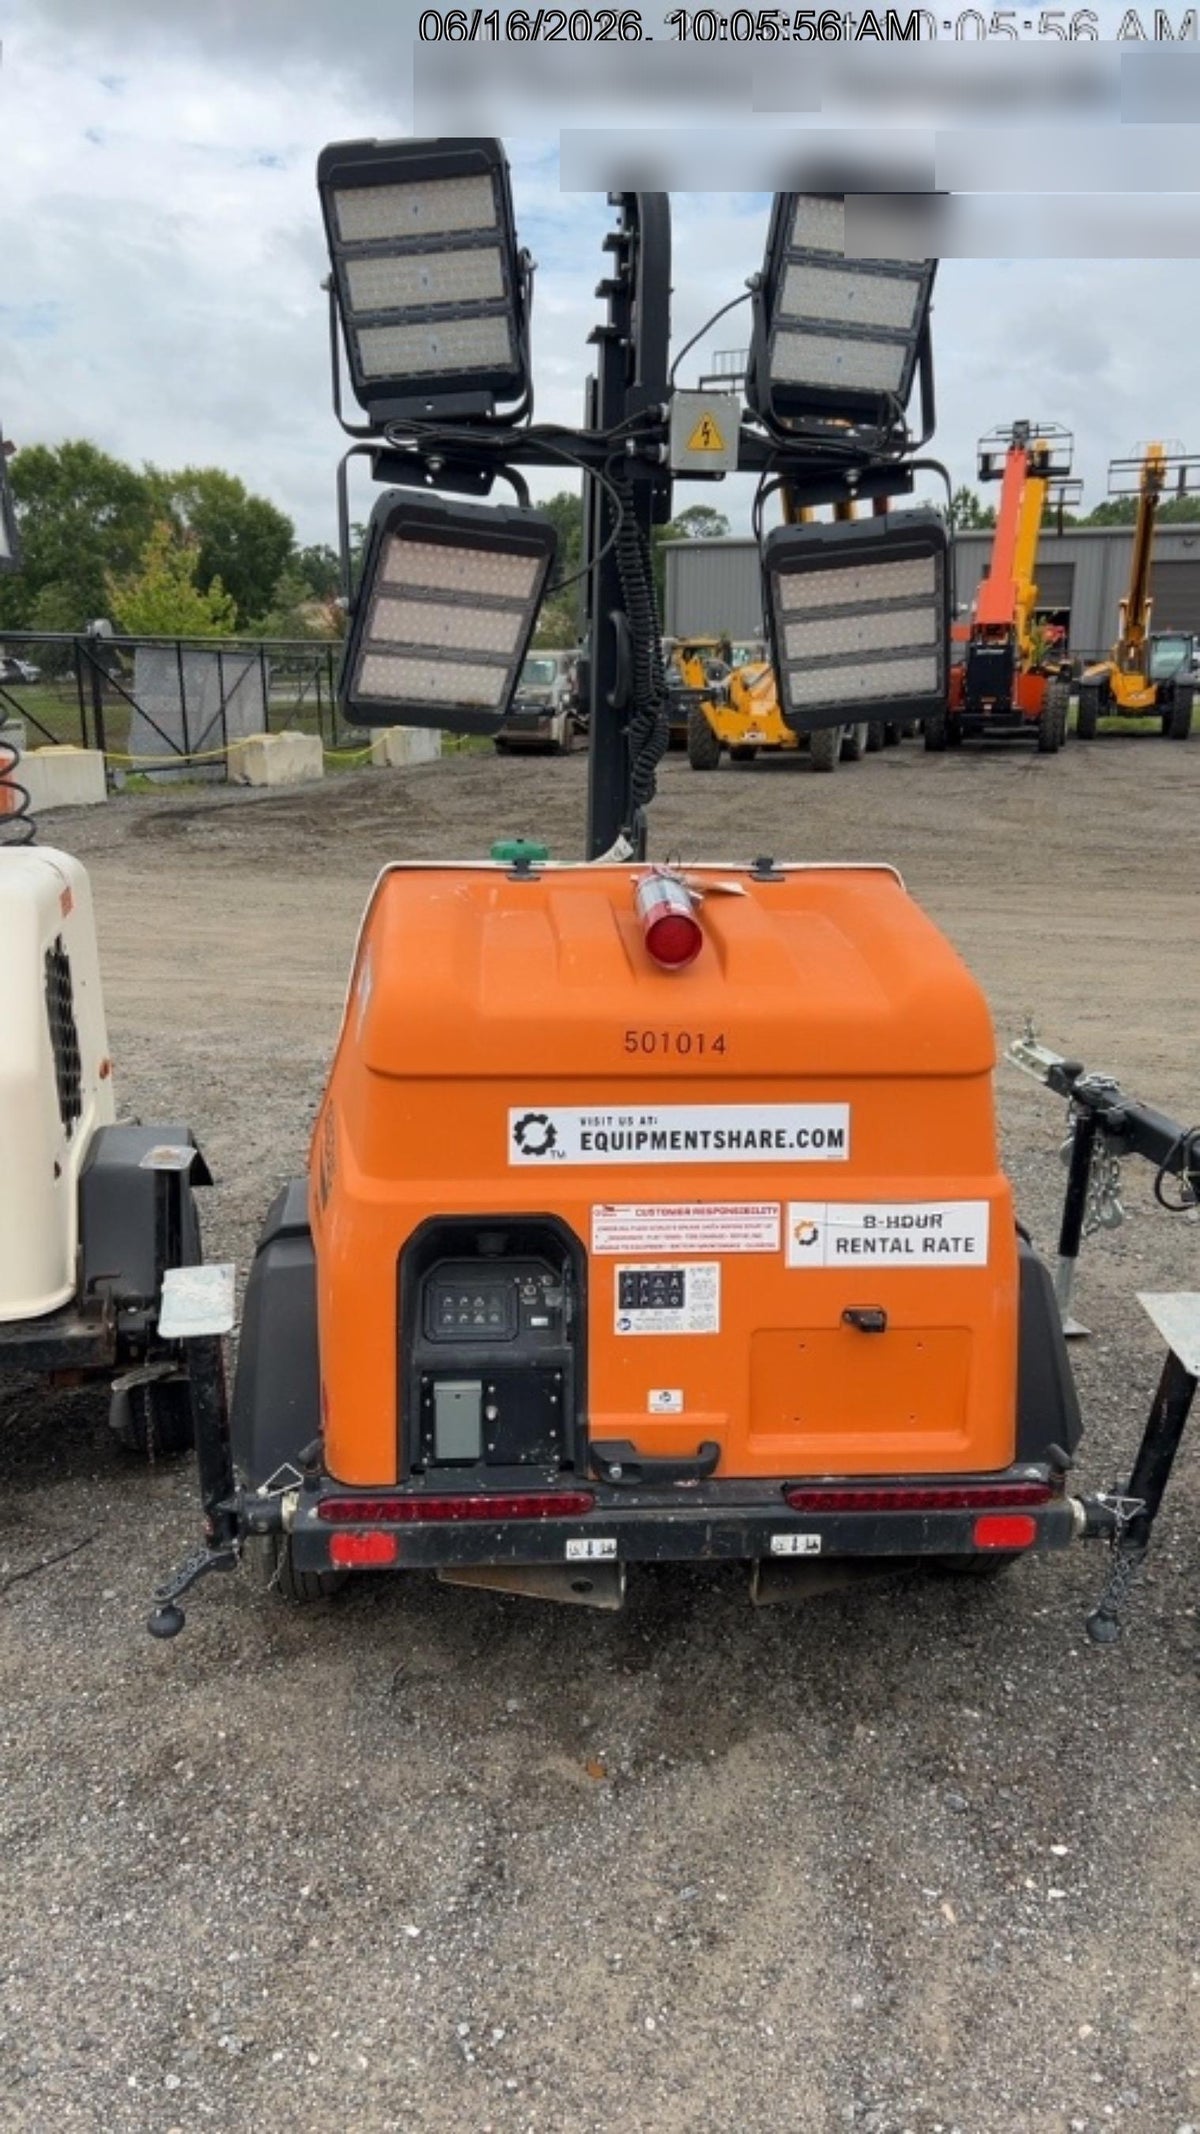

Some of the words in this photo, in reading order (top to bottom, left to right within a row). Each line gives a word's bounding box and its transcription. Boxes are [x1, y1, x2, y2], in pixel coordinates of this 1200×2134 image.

[624, 1030, 726, 1055] 501014
[579, 1116, 613, 1127] VISIT
[618, 1116, 634, 1126] US
[579, 1128, 844, 1152] EQUIPMENTSHARE.COM
[635, 1207, 690, 1217] CUSTOMER
[836, 1237, 914, 1254] RENTAL
[922, 1236, 975, 1253] RATE
